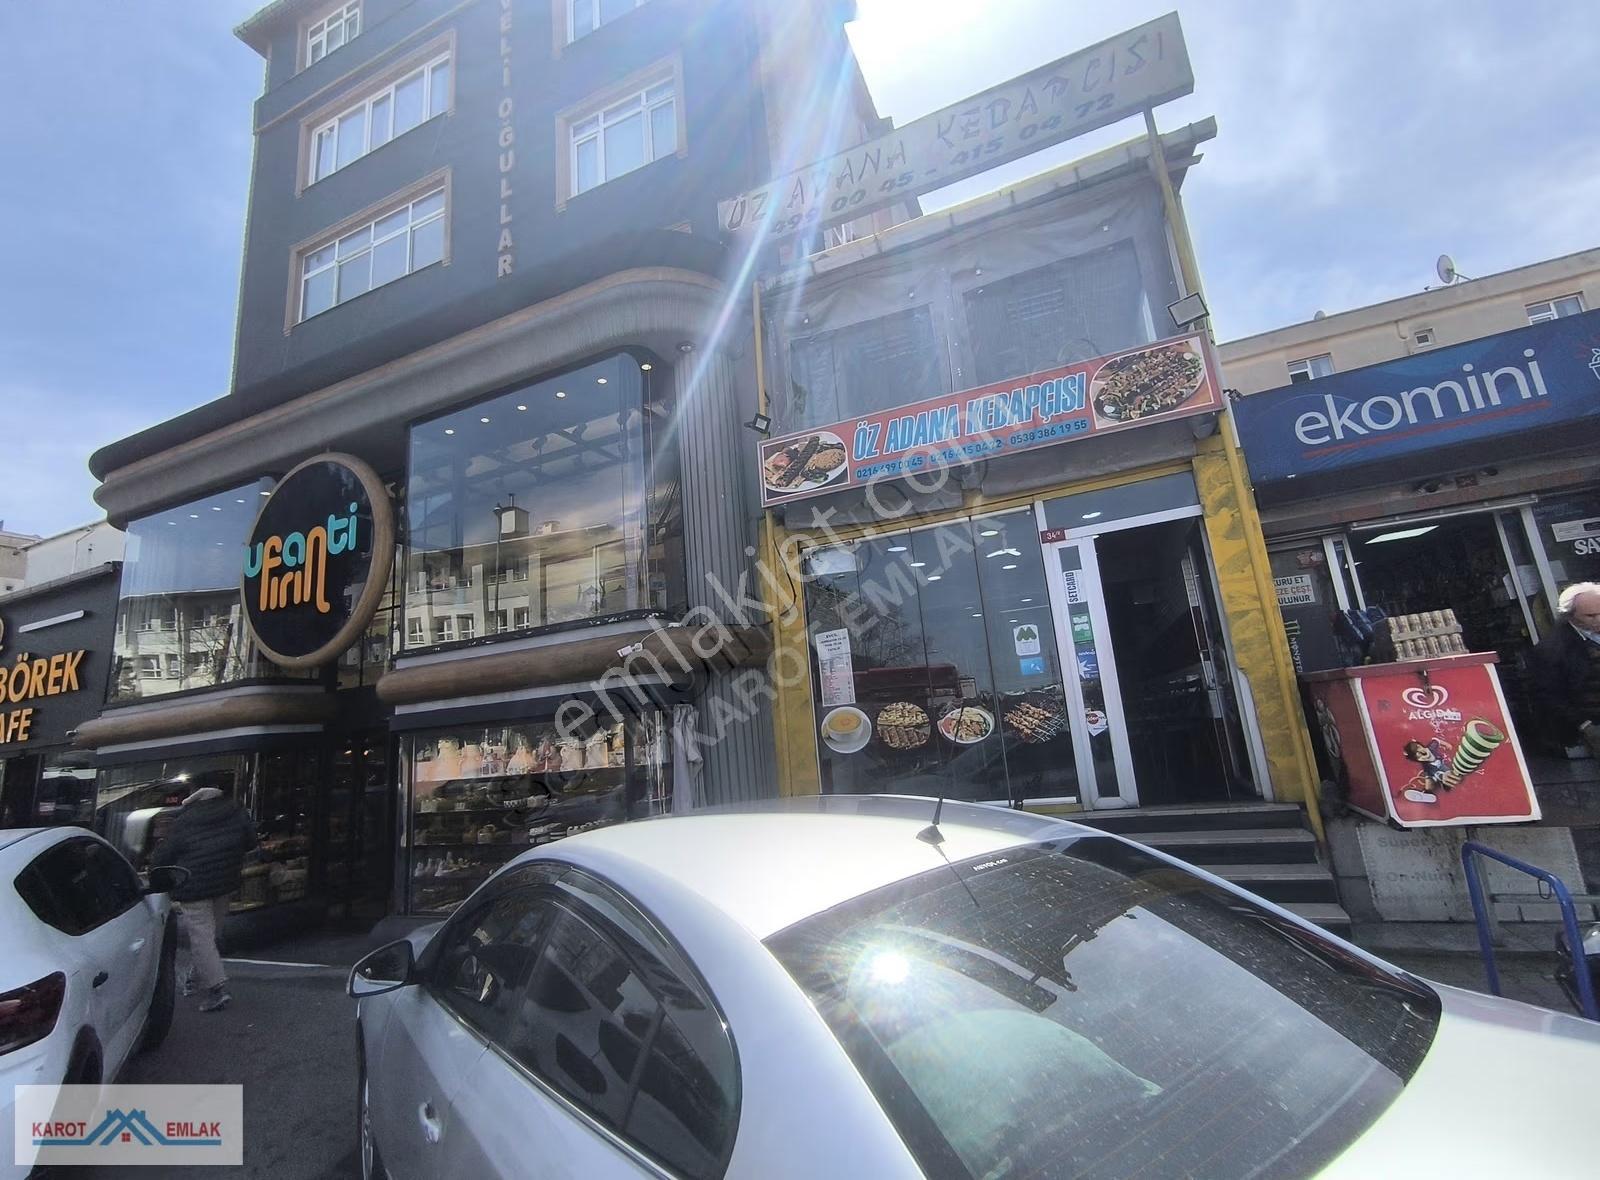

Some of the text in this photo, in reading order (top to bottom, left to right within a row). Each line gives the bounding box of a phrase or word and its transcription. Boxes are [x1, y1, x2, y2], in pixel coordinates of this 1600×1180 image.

[1295, 348, 1548, 445] ekomini
[852, 371, 1087, 462] ÖZ ADANA KEBAPÇISI
[1010, 430, 1036, 446] 0538
[1038, 424, 1056, 440] 386
[1059, 423, 1071, 437] 19
[1074, 419, 1088, 431] 55
[1574, 537, 1600, 555] SA
[1065, 571, 1079, 603] SETCARD
[1275, 588, 1289, 596] EZE
[1295, 576, 1304, 584] ET
[1278, 594, 1311, 605] ULUNUR
[1289, 636, 1303, 673] MONSTE
